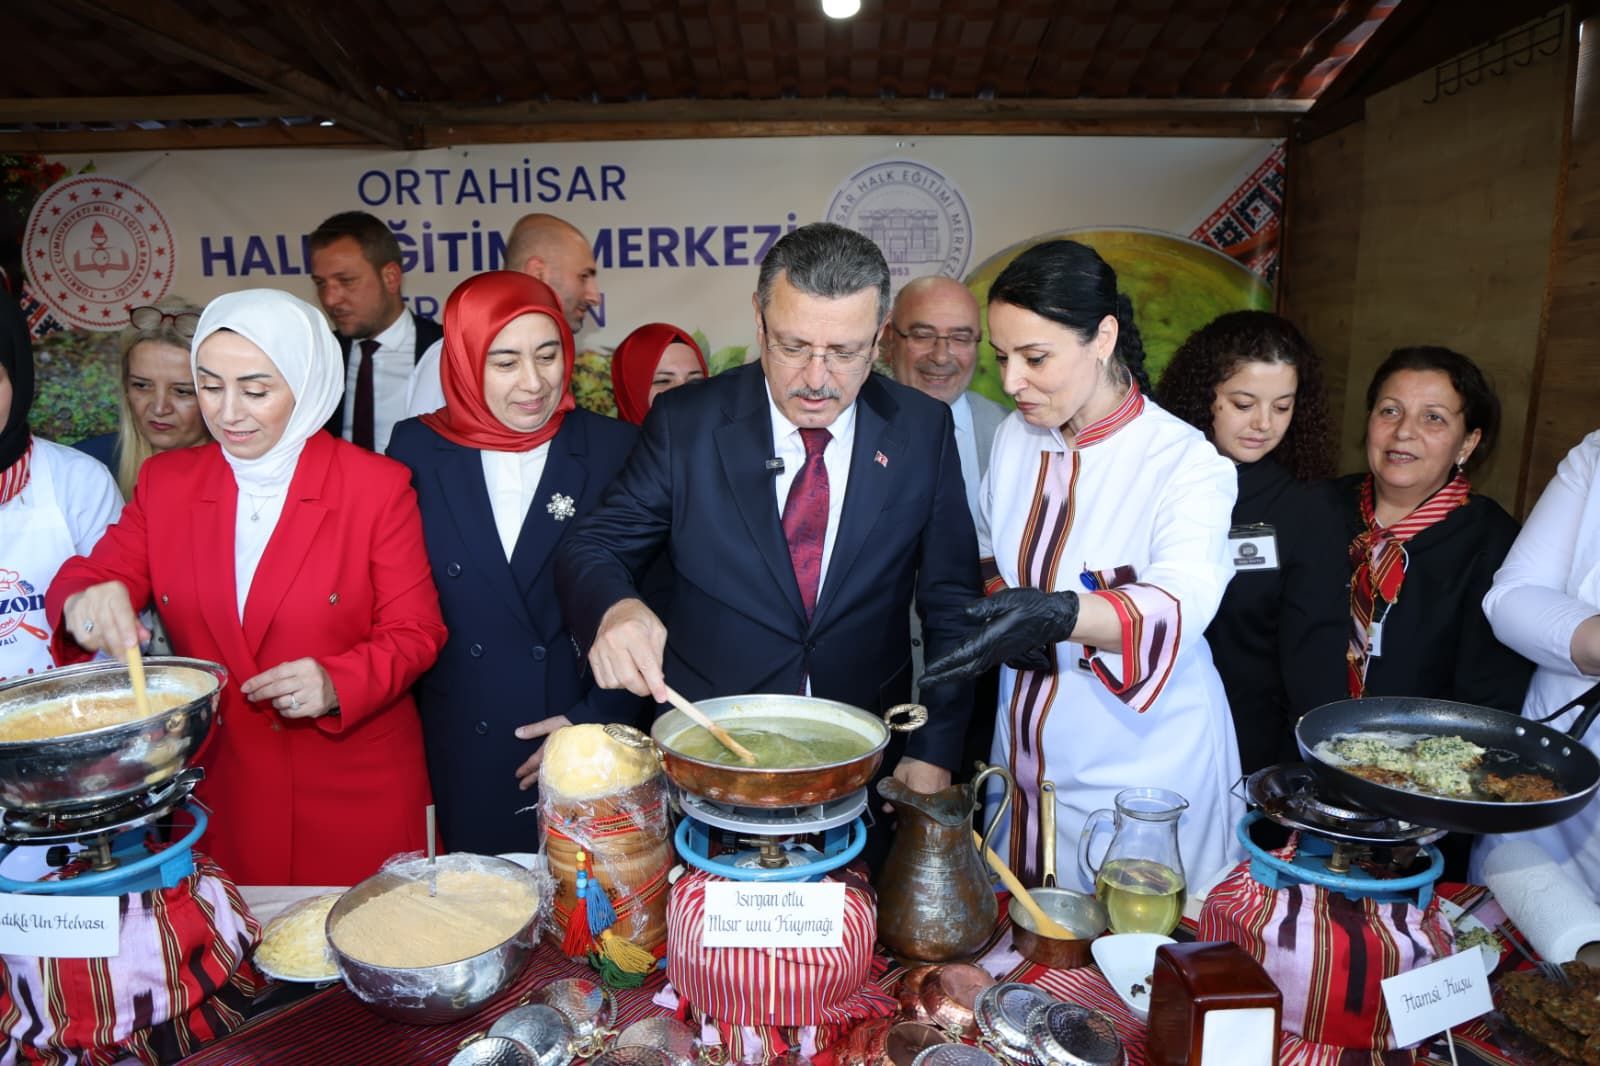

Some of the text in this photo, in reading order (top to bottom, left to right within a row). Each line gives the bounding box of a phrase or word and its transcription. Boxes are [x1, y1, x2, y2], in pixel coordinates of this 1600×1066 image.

[358, 159, 626, 206] ORTAHİSAR
[836, 194, 855, 221] SAR
[858, 170, 895, 192] HALK
[0, 594, 46, 615] zon
[736, 890, 805, 911] Isırgan otlu
[0, 912, 105, 933] dıklı Un Helvası
[708, 913, 834, 937] Mısır unu Kuymağı
[1400, 976, 1473, 1014] Hamsi Kuşu
